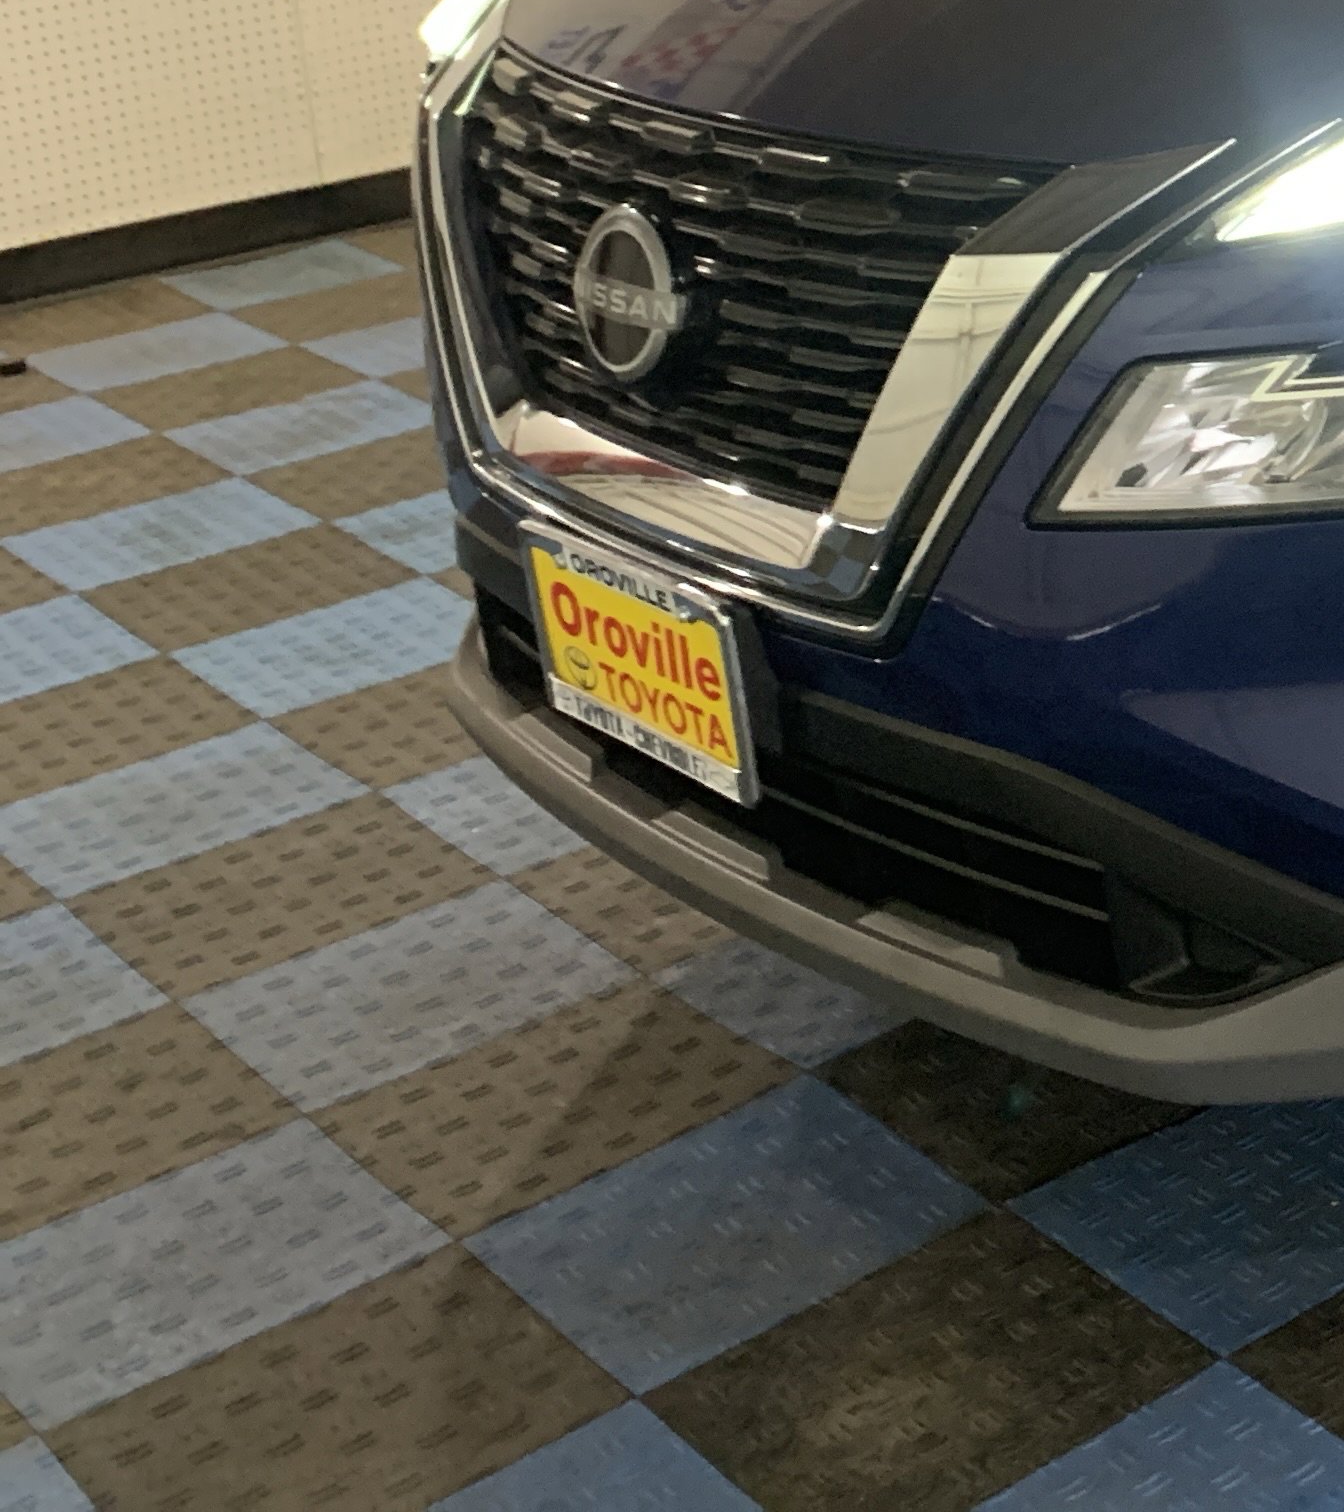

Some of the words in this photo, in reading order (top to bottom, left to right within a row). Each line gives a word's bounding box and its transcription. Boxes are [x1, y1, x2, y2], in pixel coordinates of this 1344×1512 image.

[588, 280, 678, 326] SSAN
[570, 553, 671, 612] OROVILLE
[550, 581, 721, 702] Oroville
[598, 661, 733, 759] TOYOTA
